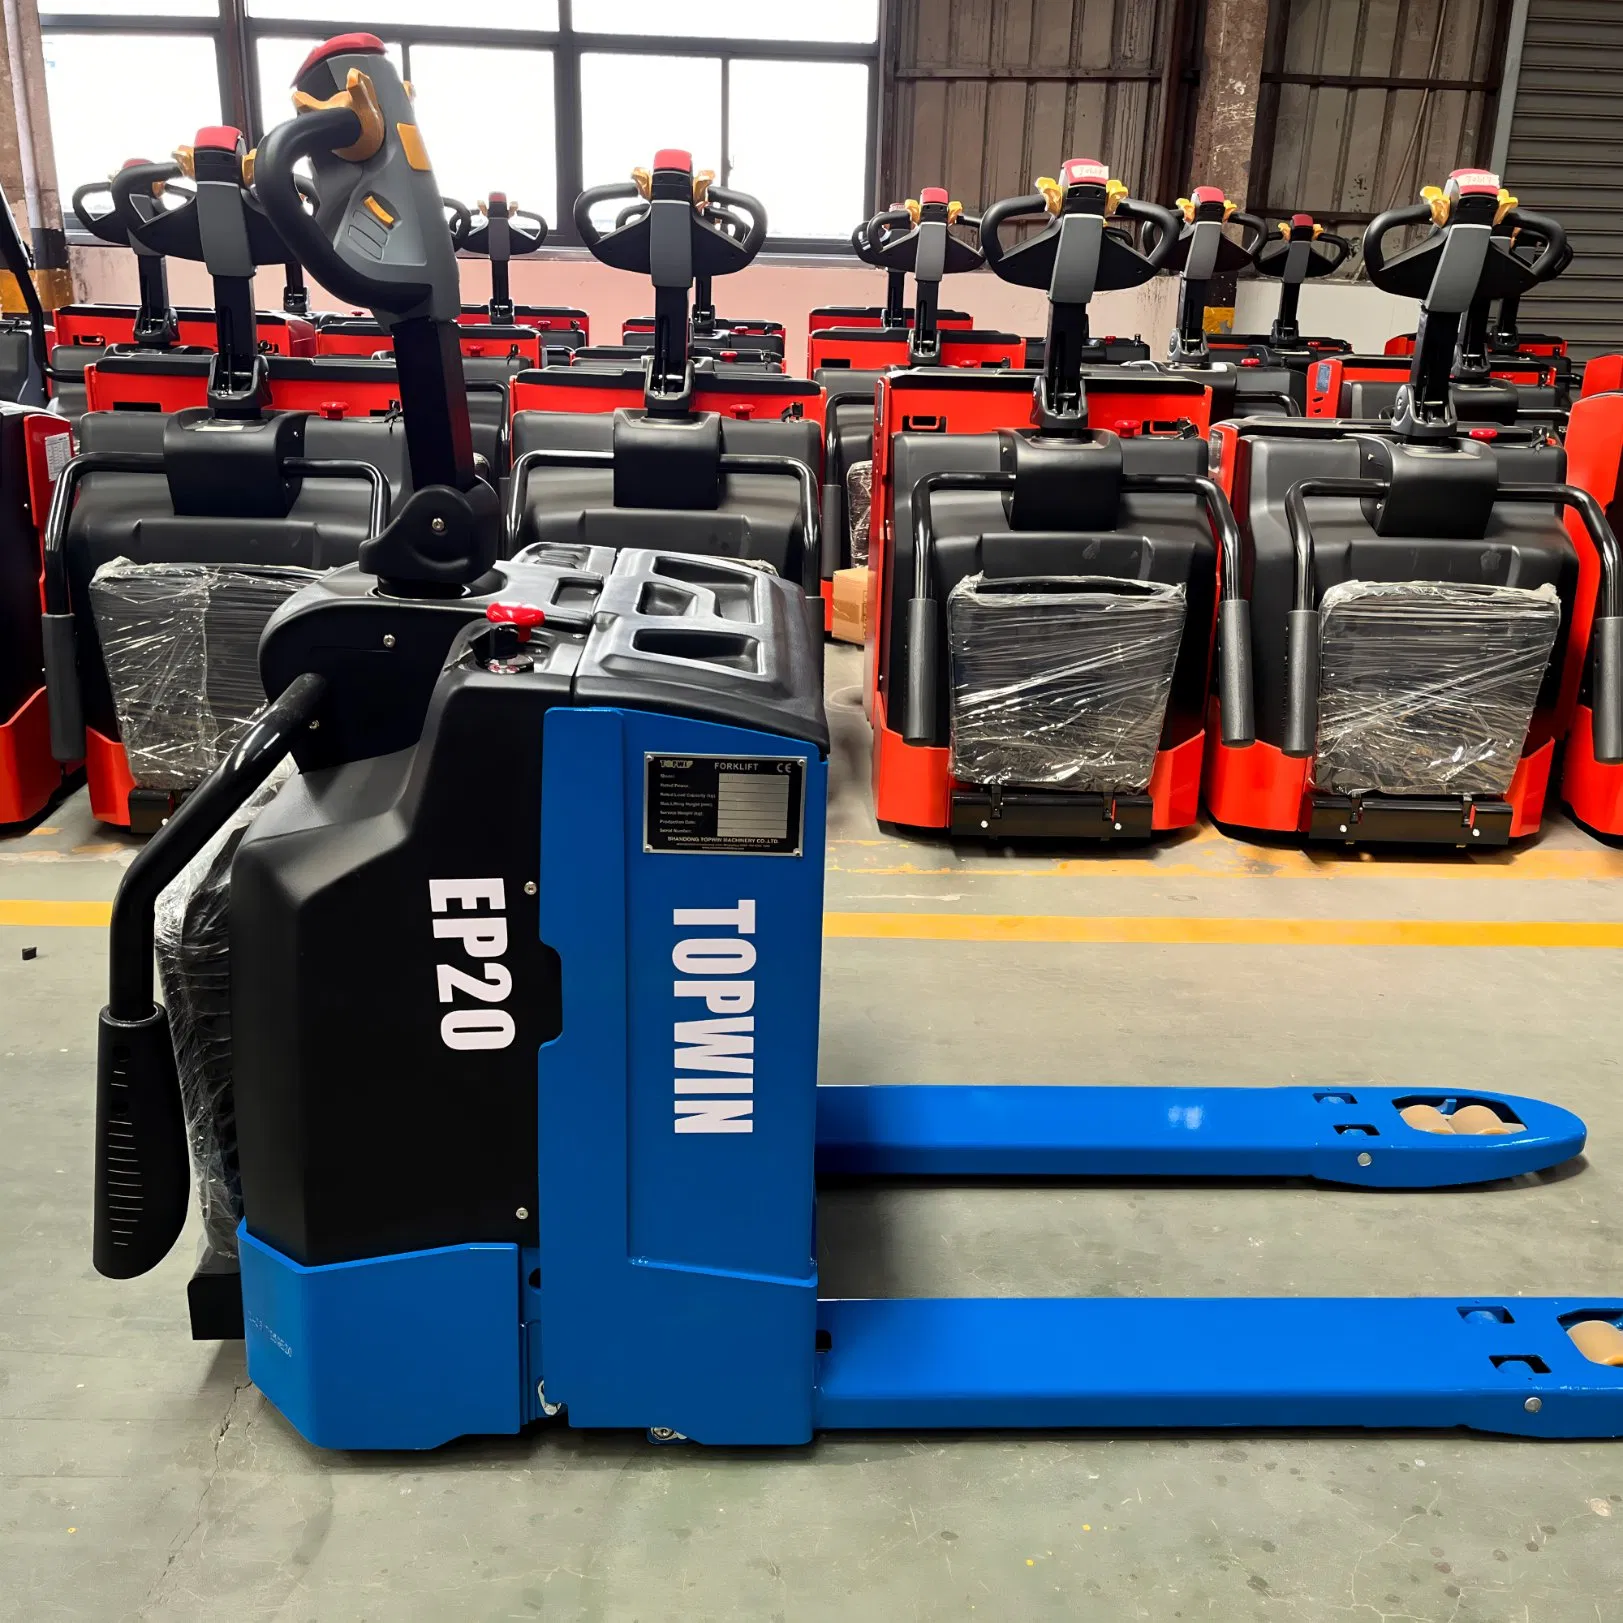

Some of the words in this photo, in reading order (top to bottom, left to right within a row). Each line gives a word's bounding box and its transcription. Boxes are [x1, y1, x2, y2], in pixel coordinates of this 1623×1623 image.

[714, 762, 759, 771] FORKLIFT
[429, 878, 516, 1050] EP20
[672, 899, 757, 1133] TOPWIN
